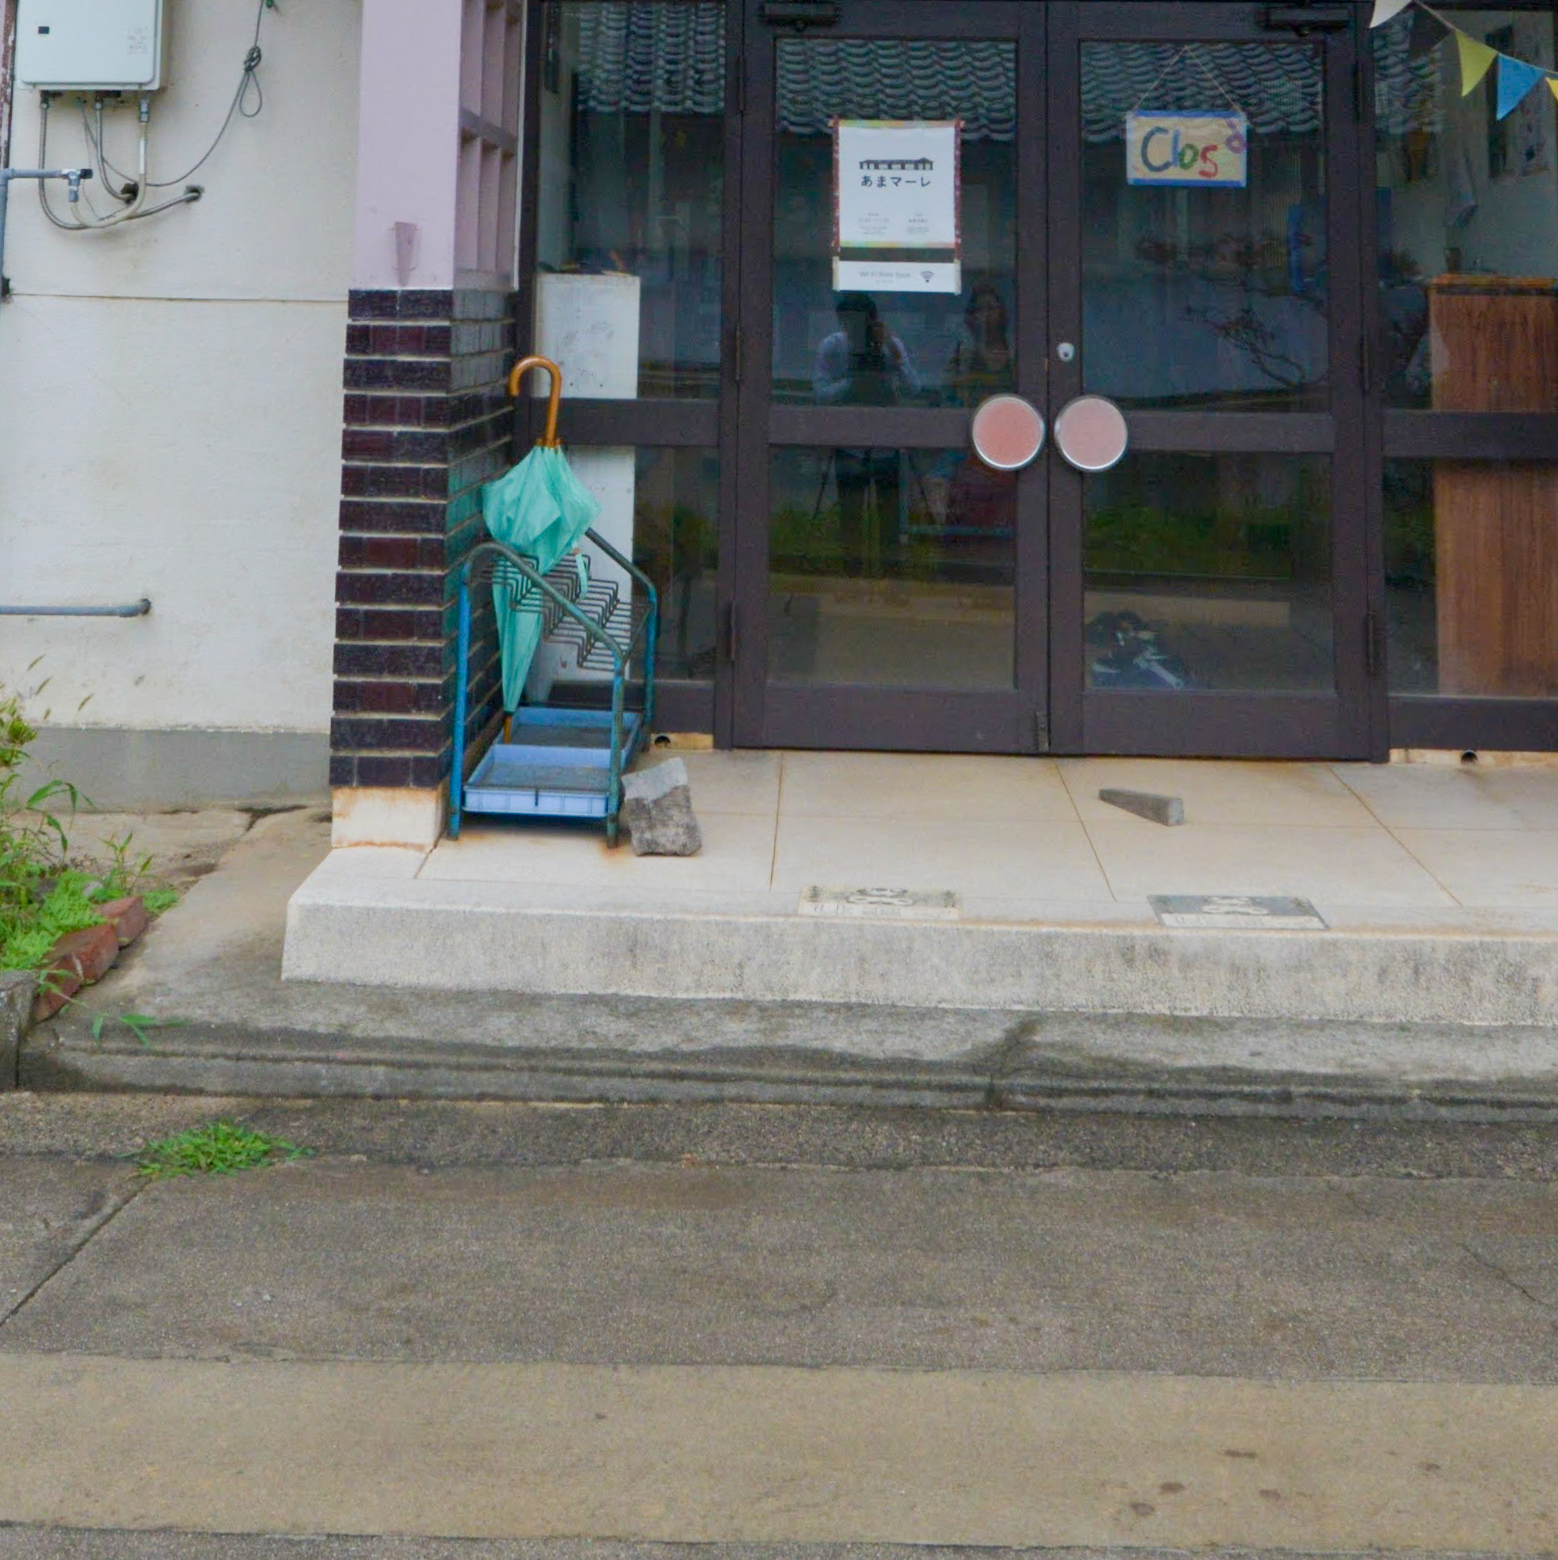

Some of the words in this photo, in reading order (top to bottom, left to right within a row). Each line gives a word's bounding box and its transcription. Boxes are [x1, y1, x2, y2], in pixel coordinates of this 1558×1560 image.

[861, 175, 931, 188] あまマーレ
